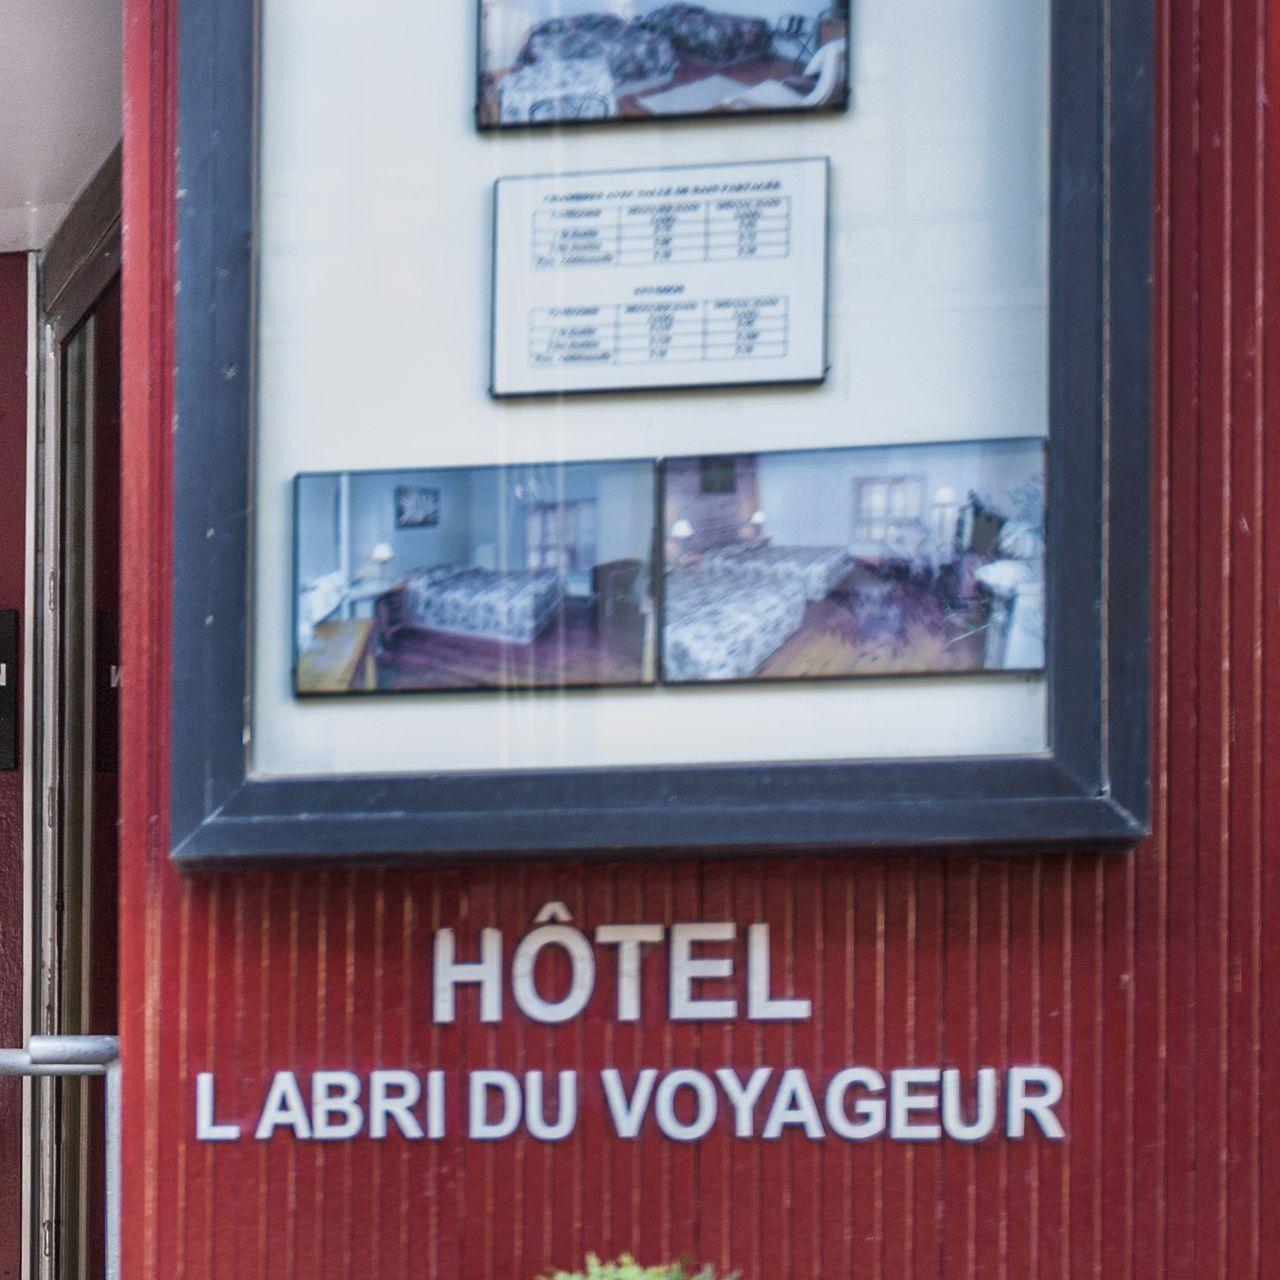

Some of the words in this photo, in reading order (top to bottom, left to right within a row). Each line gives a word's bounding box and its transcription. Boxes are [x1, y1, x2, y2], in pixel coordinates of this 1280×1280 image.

[432, 902, 813, 1024] HÔTEL
[195, 1071, 240, 1141] L
[255, 1069, 445, 1140] ABRI
[468, 1068, 577, 1142] DU
[601, 1065, 1066, 1142] VOYAGEUR
